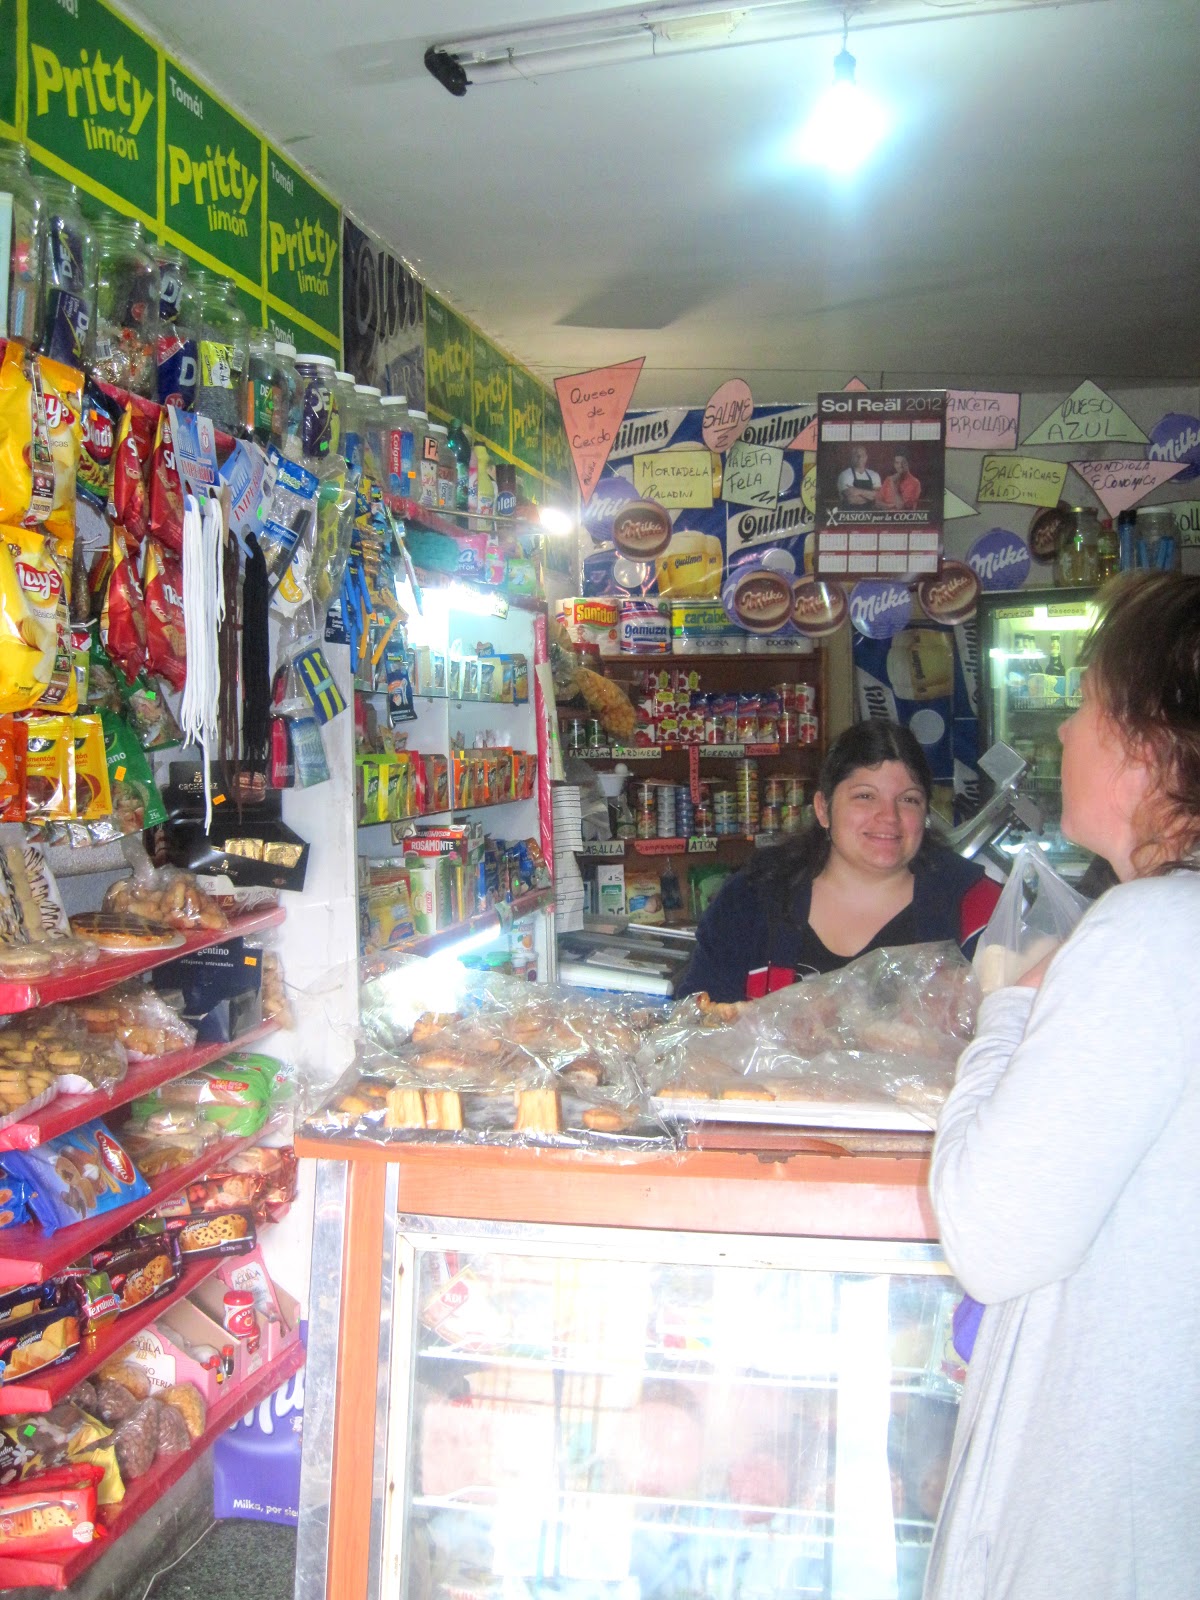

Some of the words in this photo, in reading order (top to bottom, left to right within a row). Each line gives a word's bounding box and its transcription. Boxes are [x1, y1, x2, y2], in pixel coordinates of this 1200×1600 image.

[31, 43, 154, 135] Pritty
[169, 77, 204, 120] Tomá!
[83, 118, 139, 160] limón
[168, 145, 259, 216] Pritty
[271, 161, 295, 197] Tomá!
[207, 205, 249, 237] limón
[269, 217, 338, 277] Pritty
[297, 270, 329, 297] limón
[428, 338, 471, 390] Pritty
[570, 387, 616, 405] Queso
[821, 399, 852, 413] Sol
[906, 398, 942, 412] 2012
[587, 406, 605, 419] de
[703, 398, 750, 429] SALAME
[1061, 398, 1114, 422] QUESO
[612, 417, 671, 452] uilmes
[950, 415, 1018, 439] RROLLADA
[1047, 422, 1128, 441] AZUL
[391, 433, 400, 473] Colgate
[642, 461, 710, 477] MORTADELA
[838, 511, 872, 522] PASIÓN
[872, 514, 884, 523] por
[884, 512, 893, 522] la
[893, 512, 929, 522] COCINA
[621, 519, 662, 539] Milka
[674, 554, 704, 569] Quilmes
[969, 544, 1030, 579] Milka
[741, 590, 783, 610] Milka
[928, 575, 968, 606] Milka
[850, 587, 911, 623] Milka
[684, 607, 727, 625] cartabe
[624, 623, 667, 639] gamuza
[696, 639, 729, 647] COCINA
[765, 639, 800, 647] COCINA
[615, 747, 661, 758] JARDINERA
[699, 747, 744, 758] MORRONES
[411, 839, 454, 852] ROSAMONTE
[87, 1296, 117, 1317] Terrabusi
[233, 1498, 264, 1513] Milka,
[266, 1504, 283, 1515] por
